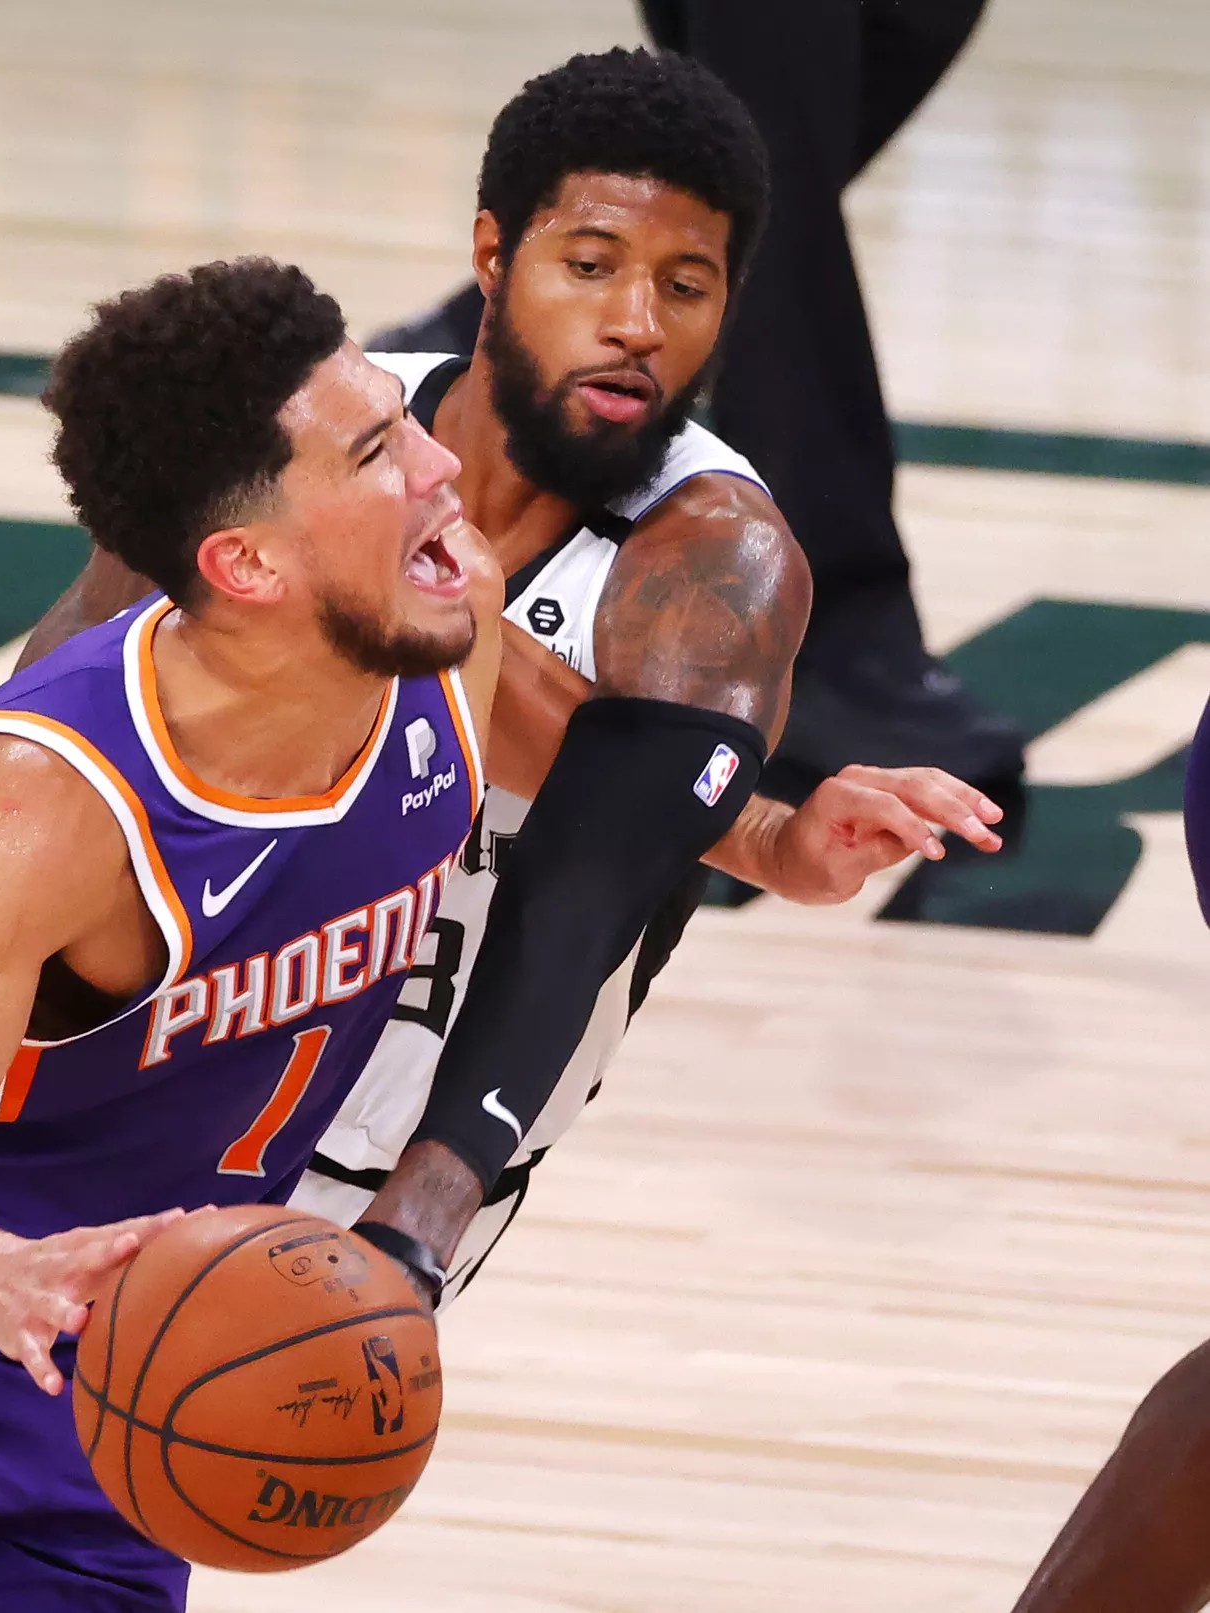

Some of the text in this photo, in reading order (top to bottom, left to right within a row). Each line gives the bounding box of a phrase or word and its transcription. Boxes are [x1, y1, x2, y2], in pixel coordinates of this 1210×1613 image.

[401, 762, 456, 816] PayPal
[138, 851, 455, 1071] PHOENI
[216, 1024, 332, 1177] 1
[247, 1474, 410, 1528] LDING
